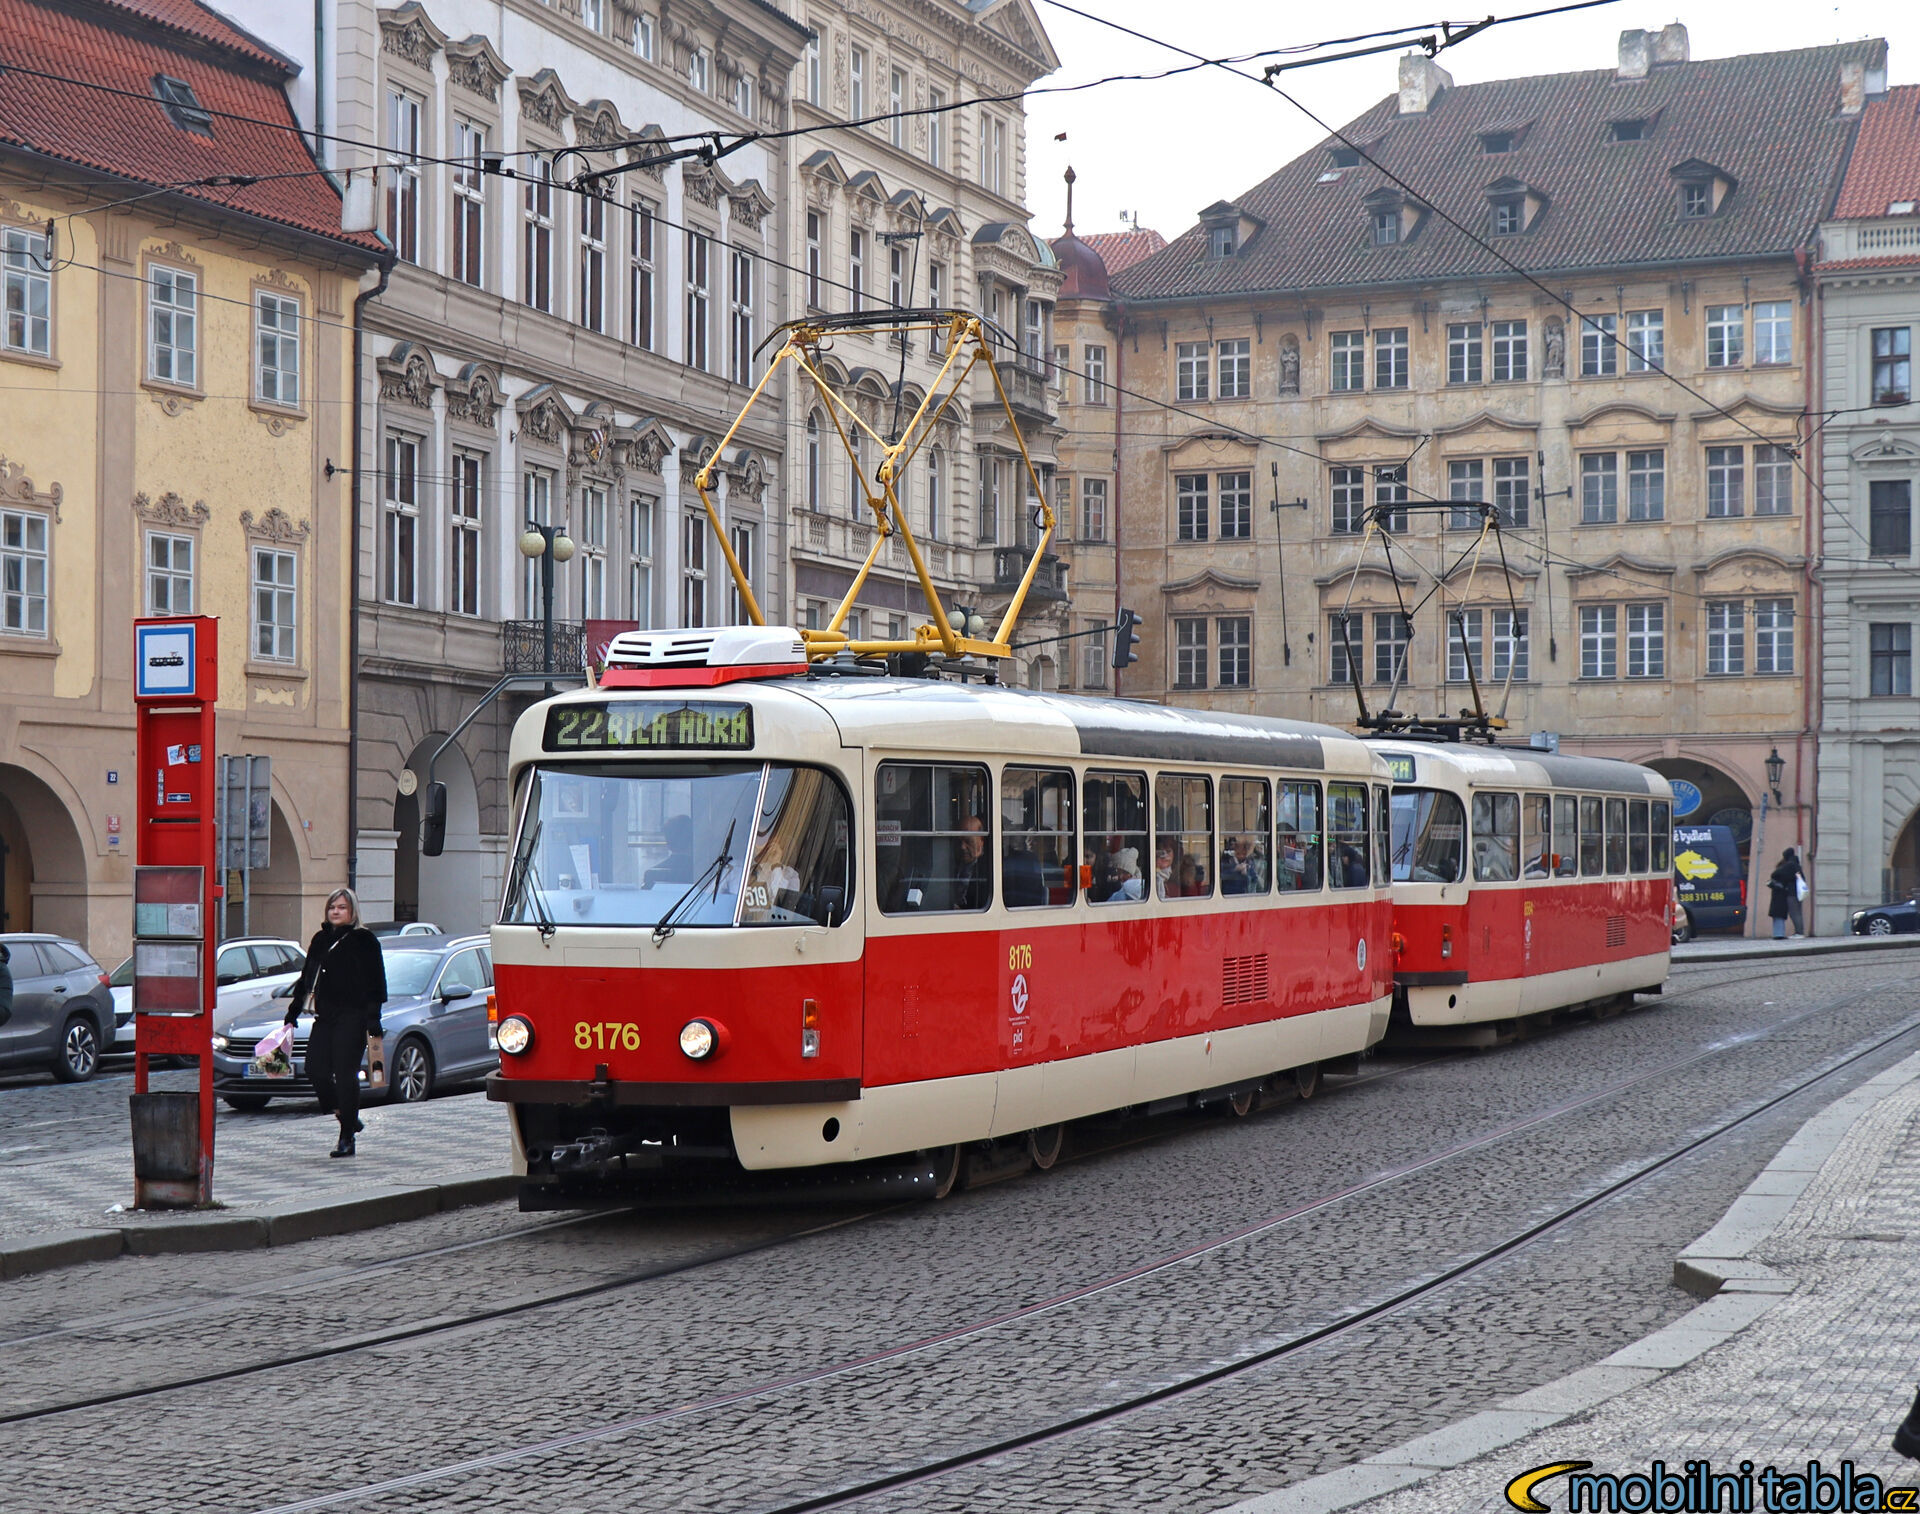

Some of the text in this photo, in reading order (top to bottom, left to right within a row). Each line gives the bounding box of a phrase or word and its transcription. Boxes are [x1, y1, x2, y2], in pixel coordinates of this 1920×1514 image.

[557, 708, 603, 745] 22
[679, 708, 748, 744] HORA
[1389, 761, 1410, 778] RA
[745, 886, 768, 907] 519
[1695, 892, 1709, 901] 311
[1009, 944, 1032, 970] 8176
[574, 1021, 641, 1051] 8176
[1013, 1028, 1023, 1047] pid
